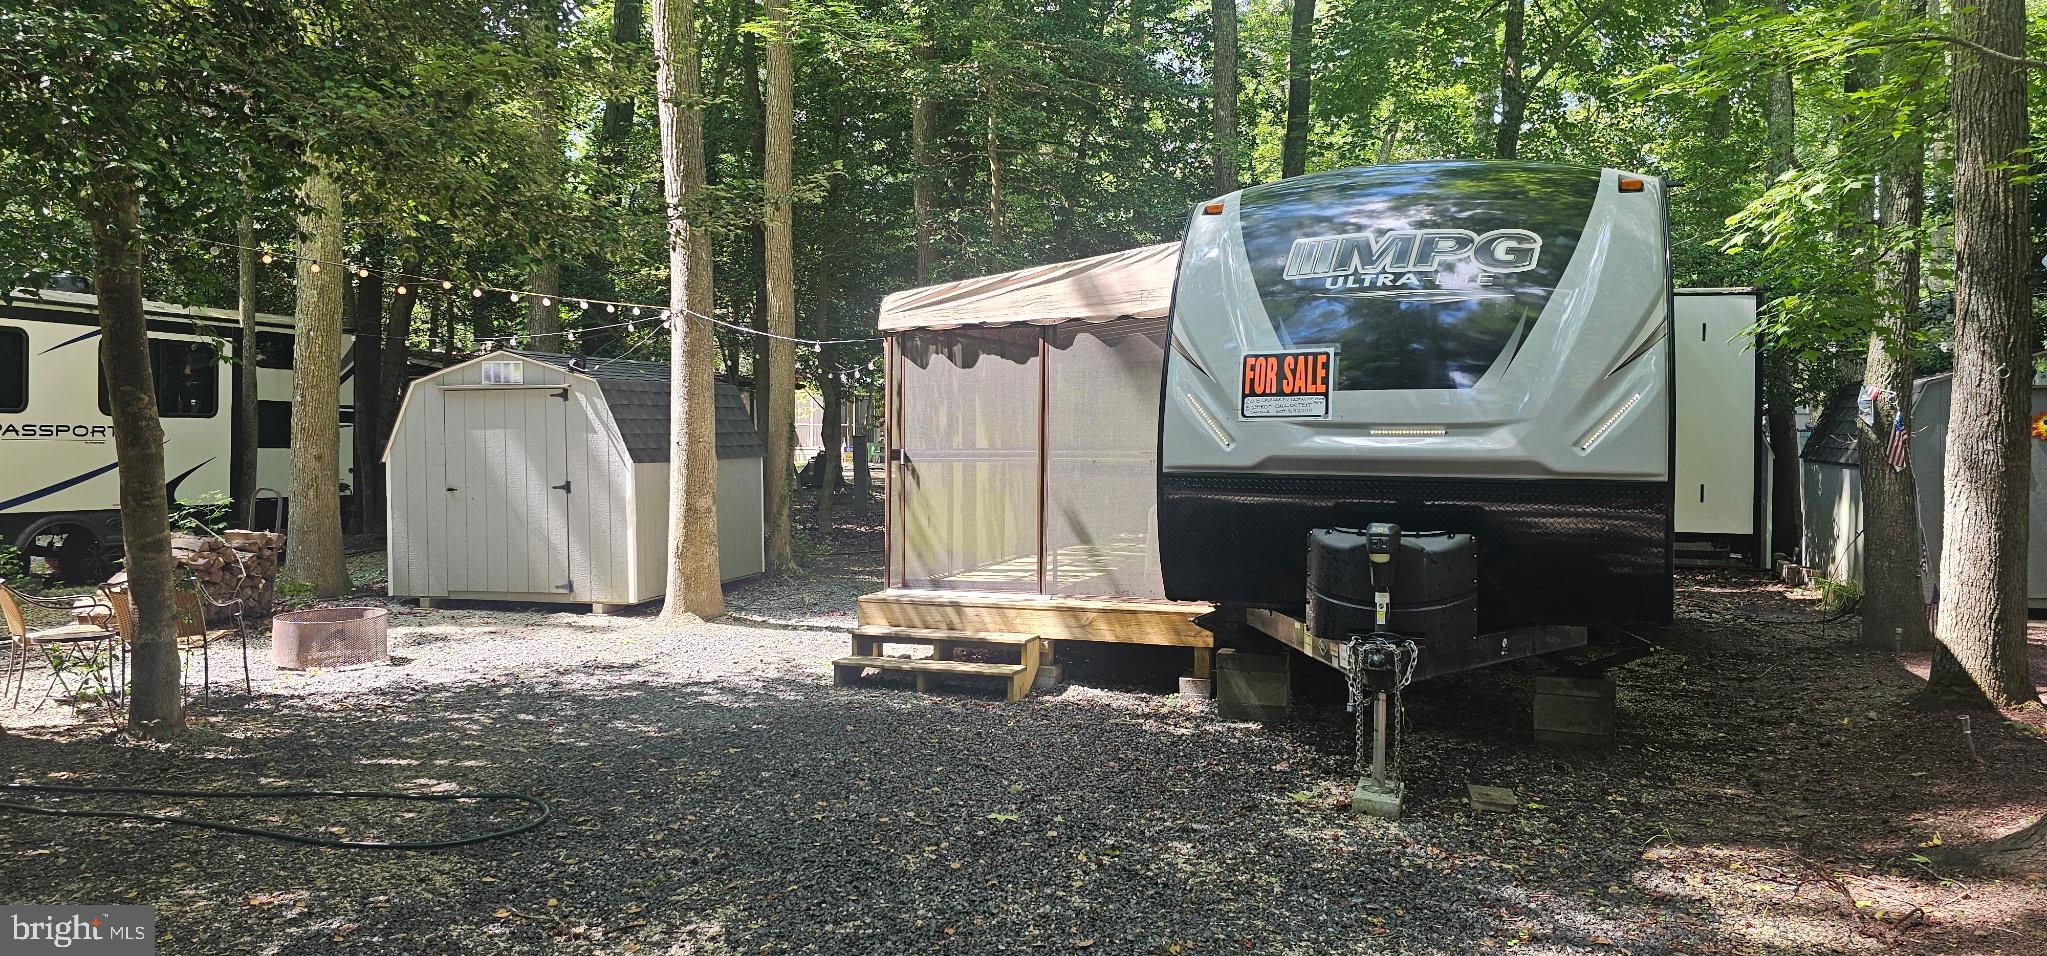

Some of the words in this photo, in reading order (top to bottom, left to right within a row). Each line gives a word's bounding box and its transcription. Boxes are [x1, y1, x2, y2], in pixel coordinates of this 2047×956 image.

[1328, 228, 1543, 273] MPG
[1325, 271, 1495, 290] ULTRA-LE
[1245, 357, 1278, 395] FOR
[1283, 355, 1327, 394] SALE
[0, 423, 115, 437] ASSPORT
